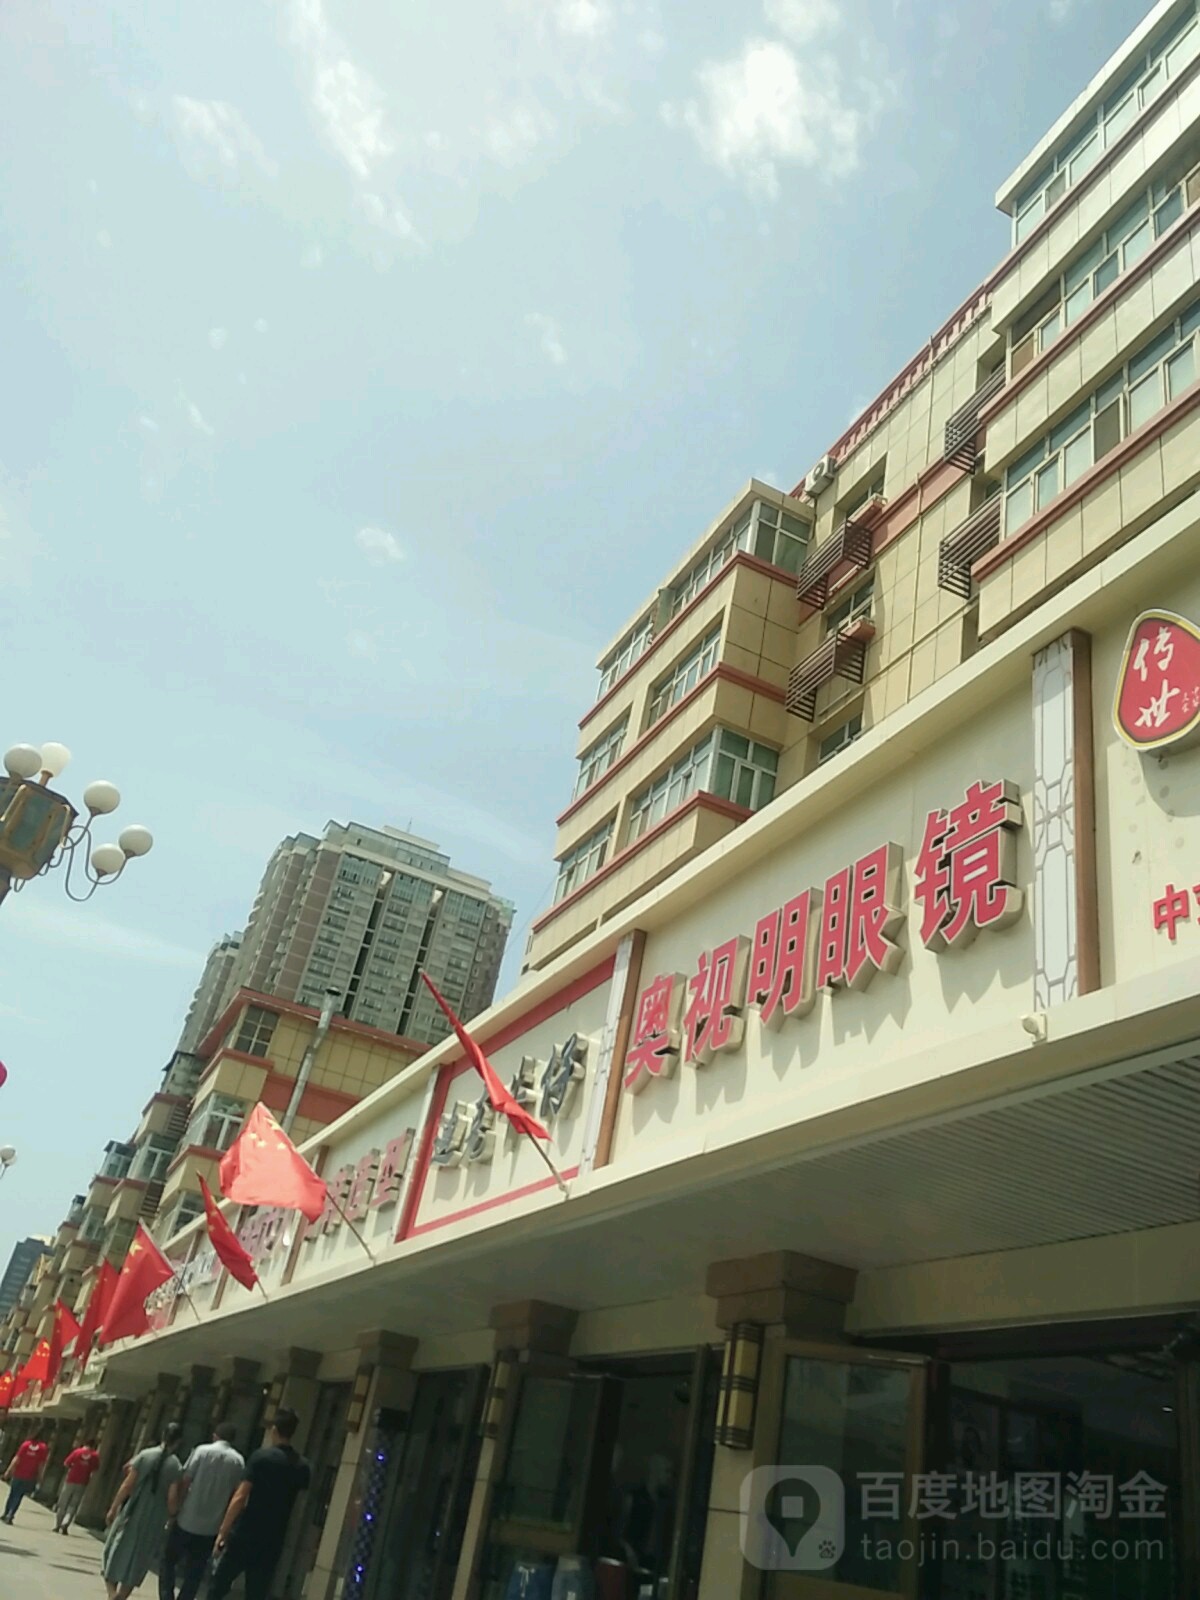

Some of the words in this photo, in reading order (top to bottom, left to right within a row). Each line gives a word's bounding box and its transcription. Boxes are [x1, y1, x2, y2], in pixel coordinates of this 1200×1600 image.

[623, 779, 1014, 1088] 奥视明眼镜
[1153, 883, 1200, 940] 中
